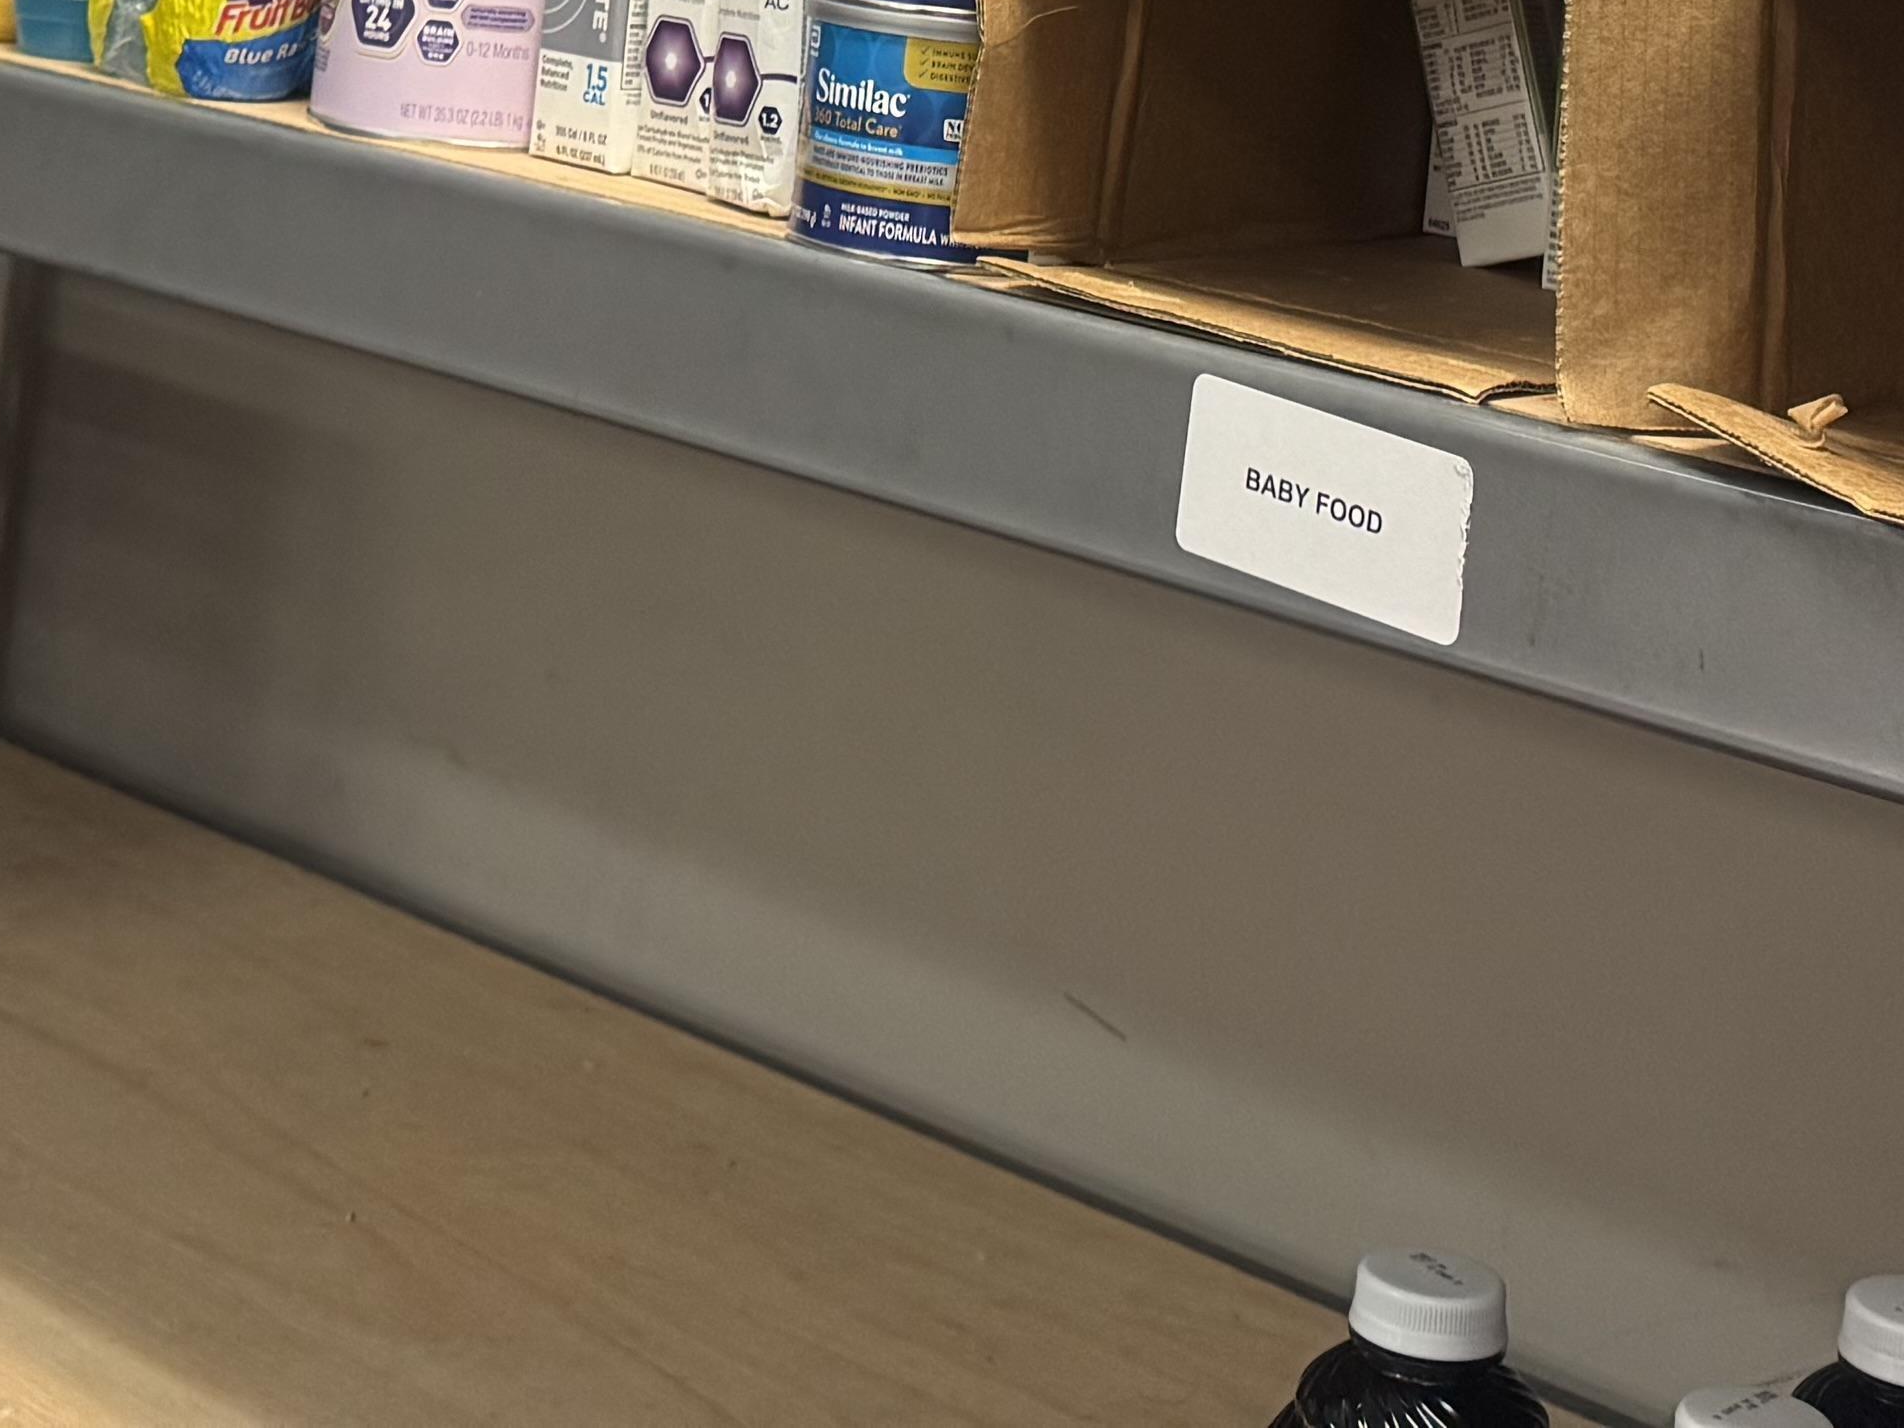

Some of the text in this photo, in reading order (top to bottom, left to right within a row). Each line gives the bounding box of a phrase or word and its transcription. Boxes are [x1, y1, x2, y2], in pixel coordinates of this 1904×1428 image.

[838, 216, 938, 246] INFANT FORMULA
[1245, 467, 1383, 534] BABY FOOD
